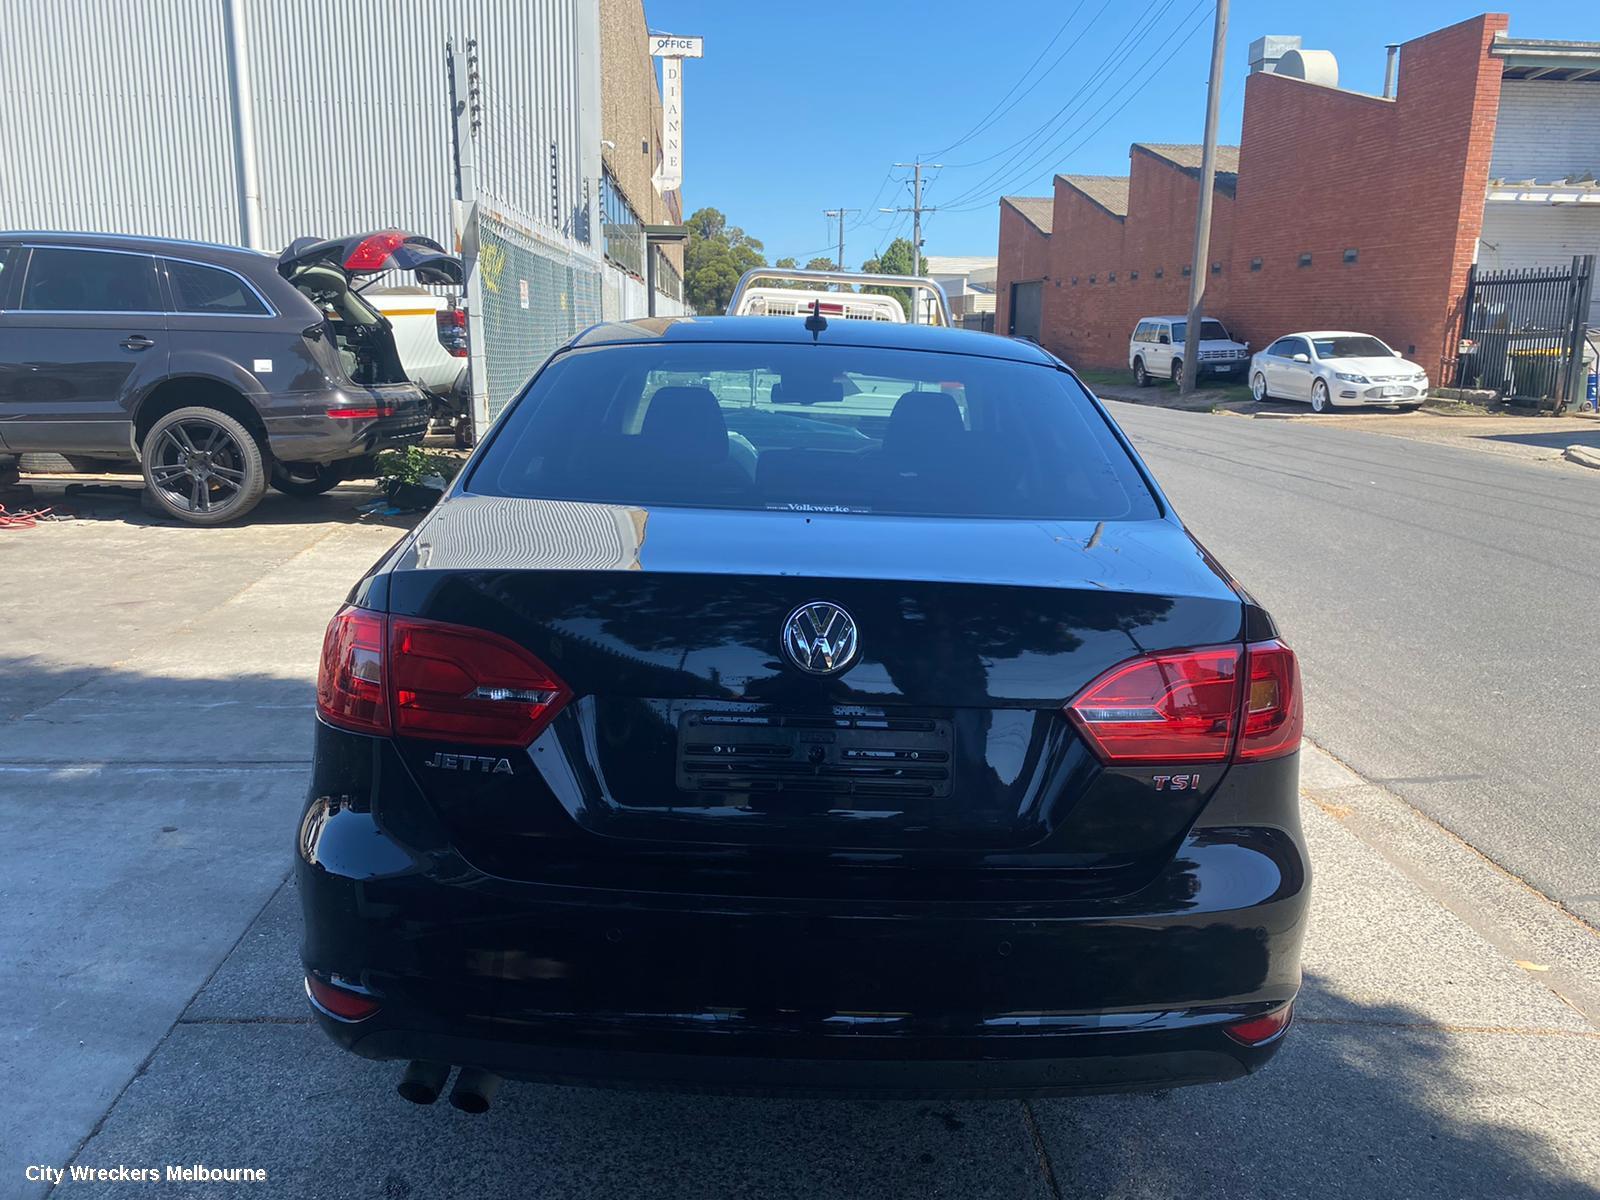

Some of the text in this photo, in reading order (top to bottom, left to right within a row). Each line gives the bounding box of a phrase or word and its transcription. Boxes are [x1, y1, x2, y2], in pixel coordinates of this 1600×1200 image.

[657, 40, 693, 49] OFFICE
[668, 68, 678, 167] DIANNE
[424, 752, 514, 775] JETTA
[1153, 774, 1200, 791] TSI
